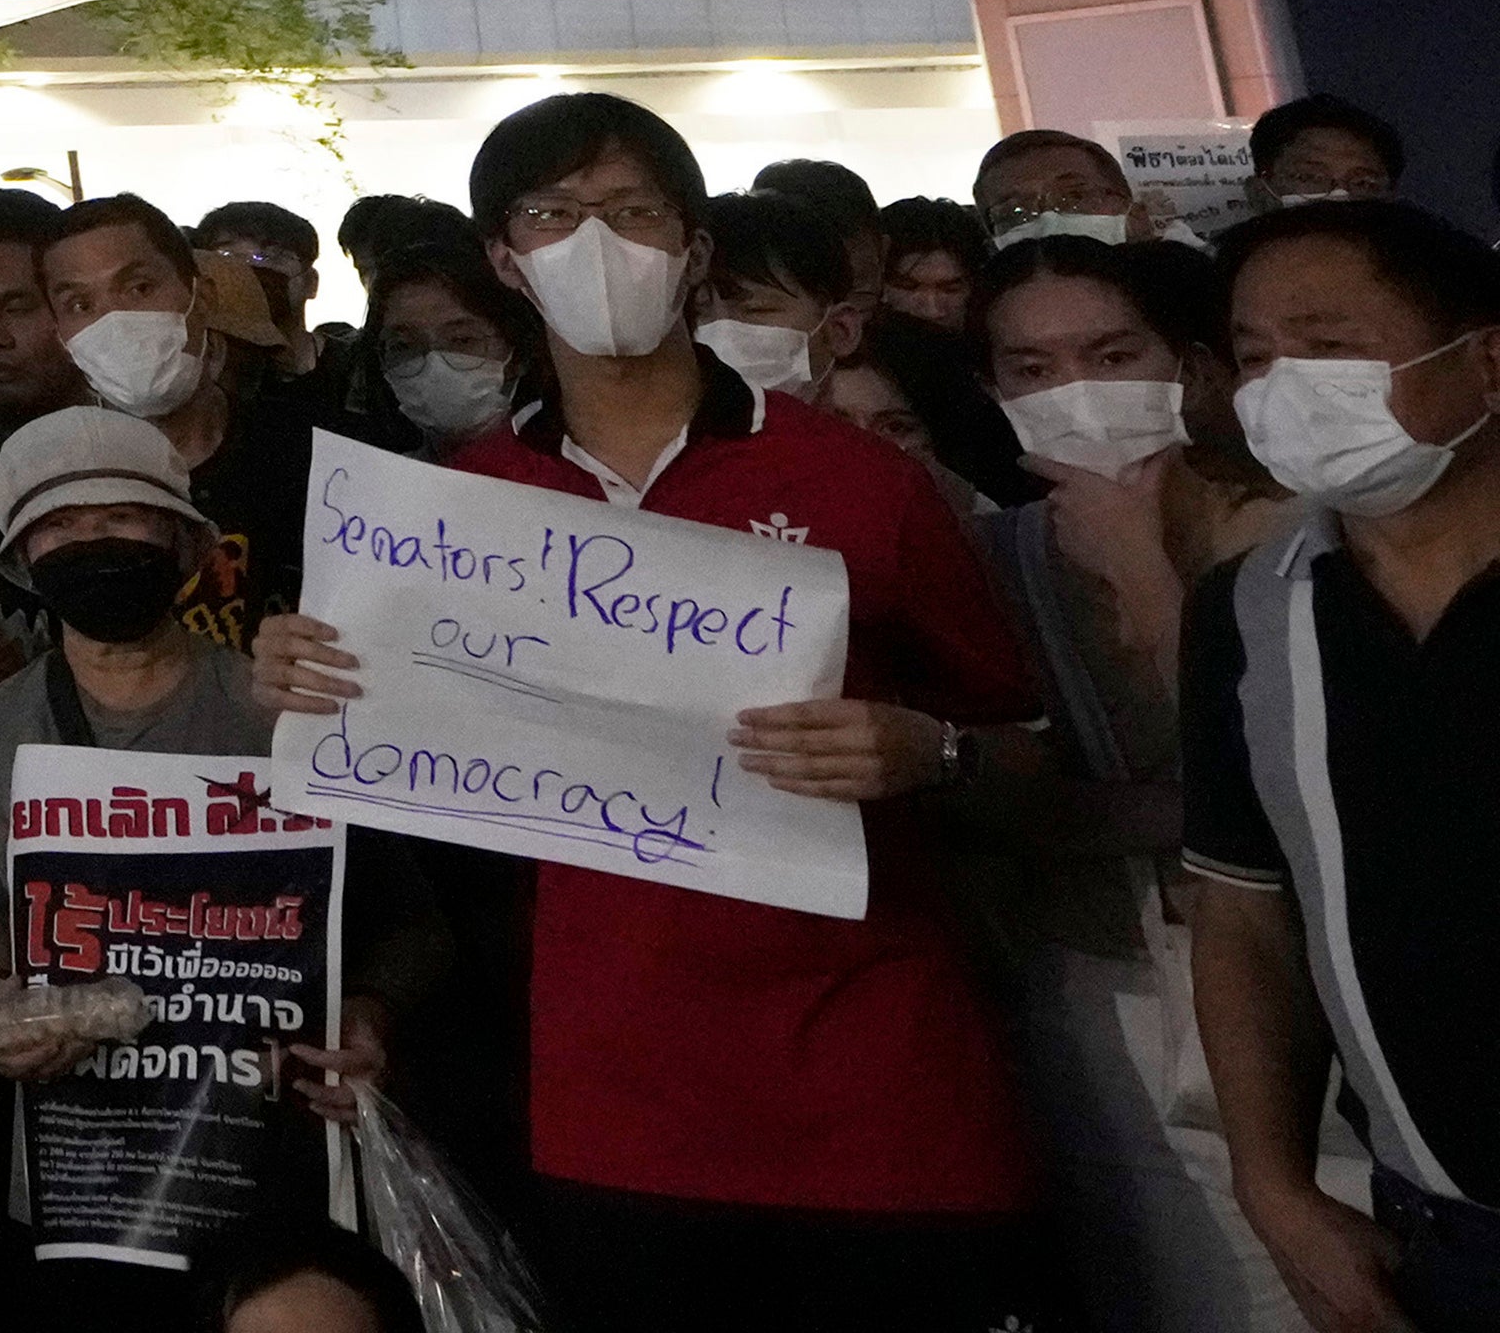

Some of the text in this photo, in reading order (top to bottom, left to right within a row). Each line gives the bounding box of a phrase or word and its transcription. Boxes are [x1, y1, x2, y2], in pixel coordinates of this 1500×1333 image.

[567, 534, 797, 655] Respect
[431, 618, 551, 667] our
[13, 786, 191, 840] ยกเลิก
